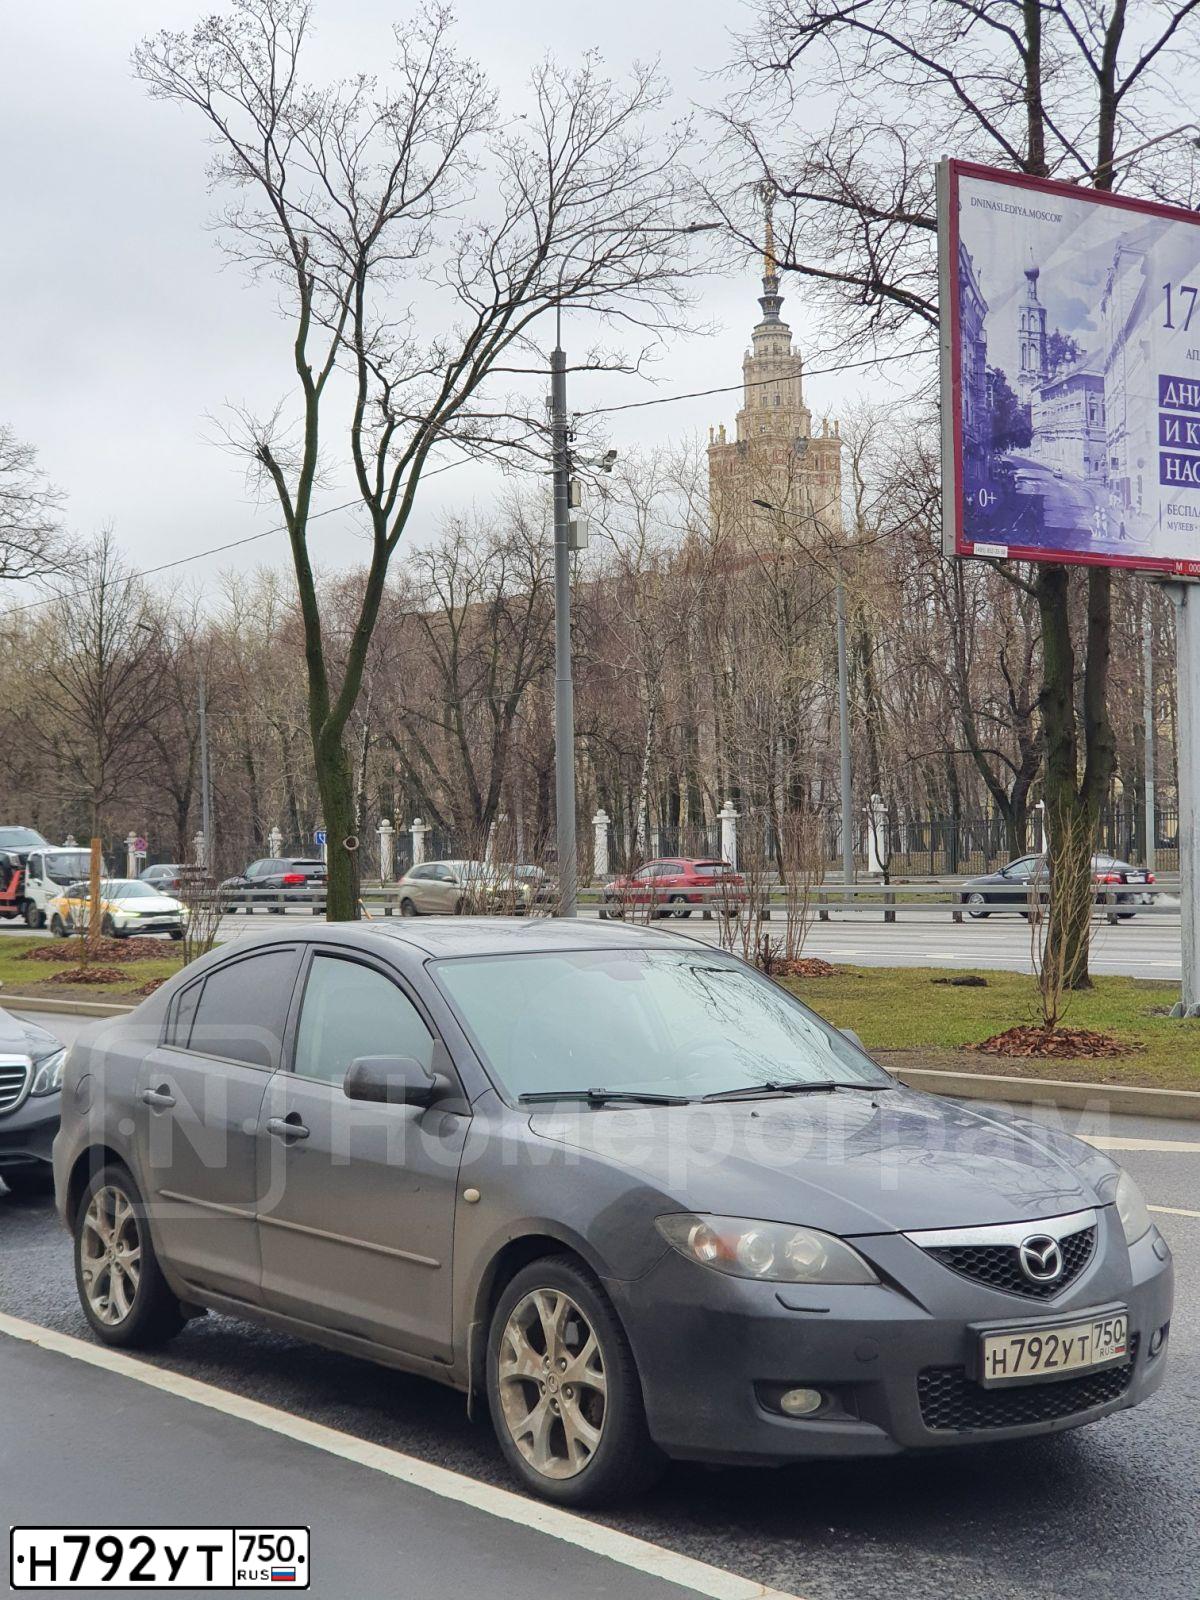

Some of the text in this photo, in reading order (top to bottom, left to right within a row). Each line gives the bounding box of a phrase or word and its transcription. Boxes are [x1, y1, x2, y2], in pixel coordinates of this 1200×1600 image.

[970, 196, 1063, 223] DNINASLEDIYA.MOSCOW
[1162, 281, 1199, 332] 17
[1164, 419, 1181, 442] И
[979, 488, 998, 507] 0+
[1094, 1318, 1123, 1349] 750
[1099, 1347, 1115, 1357] RUS
